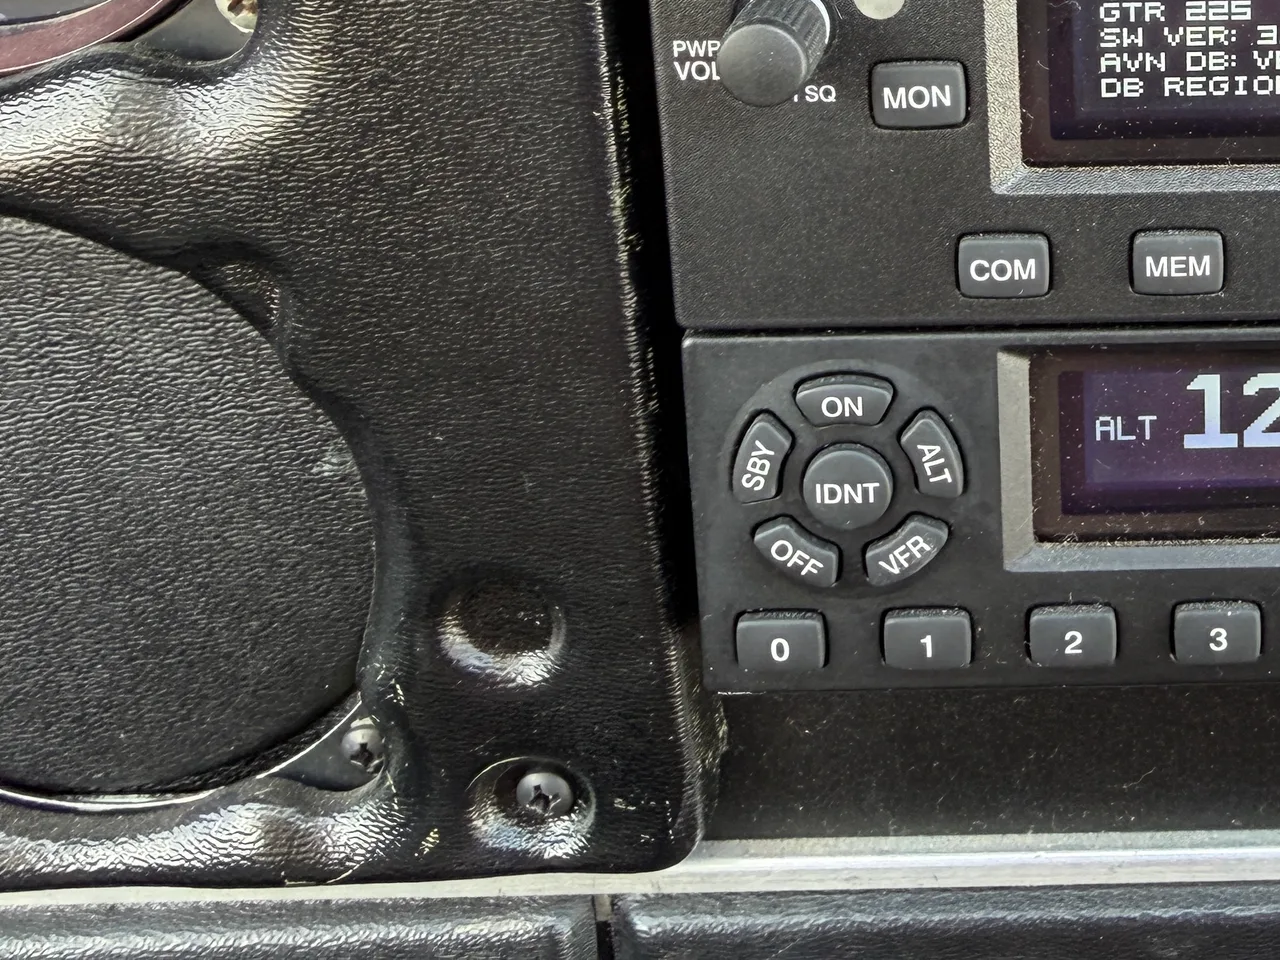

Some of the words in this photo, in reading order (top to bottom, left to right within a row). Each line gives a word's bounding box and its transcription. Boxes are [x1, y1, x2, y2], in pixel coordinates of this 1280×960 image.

[1100, 2, 1166, 22] GTR
[1185, 0, 1252, 21] 225
[1100, 27, 1143, 48] SW
[1163, 26, 1237, 47] VER:
[1100, 52, 1166, 73] AVN
[1186, 51, 1237, 72] DB:
[805, 85, 837, 102] SQ
[883, 85, 951, 109] MON
[1100, 77, 1144, 98] DB
[970, 259, 1036, 281] COM
[1145, 255, 1211, 278] MEM
[821, 397, 863, 418] ON
[1095, 415, 1157, 441] ALT
[741, 440, 775, 492] SBY
[917, 444, 952, 486] ALT
[816, 483, 880, 504] IDNT
[770, 539, 824, 576] OFF
[878, 535, 931, 575] VFR
[770, 638, 790, 661] 0
[920, 635, 932, 658] 1
[1064, 631, 1083, 654] 2
[1209, 627, 1228, 651] 3
